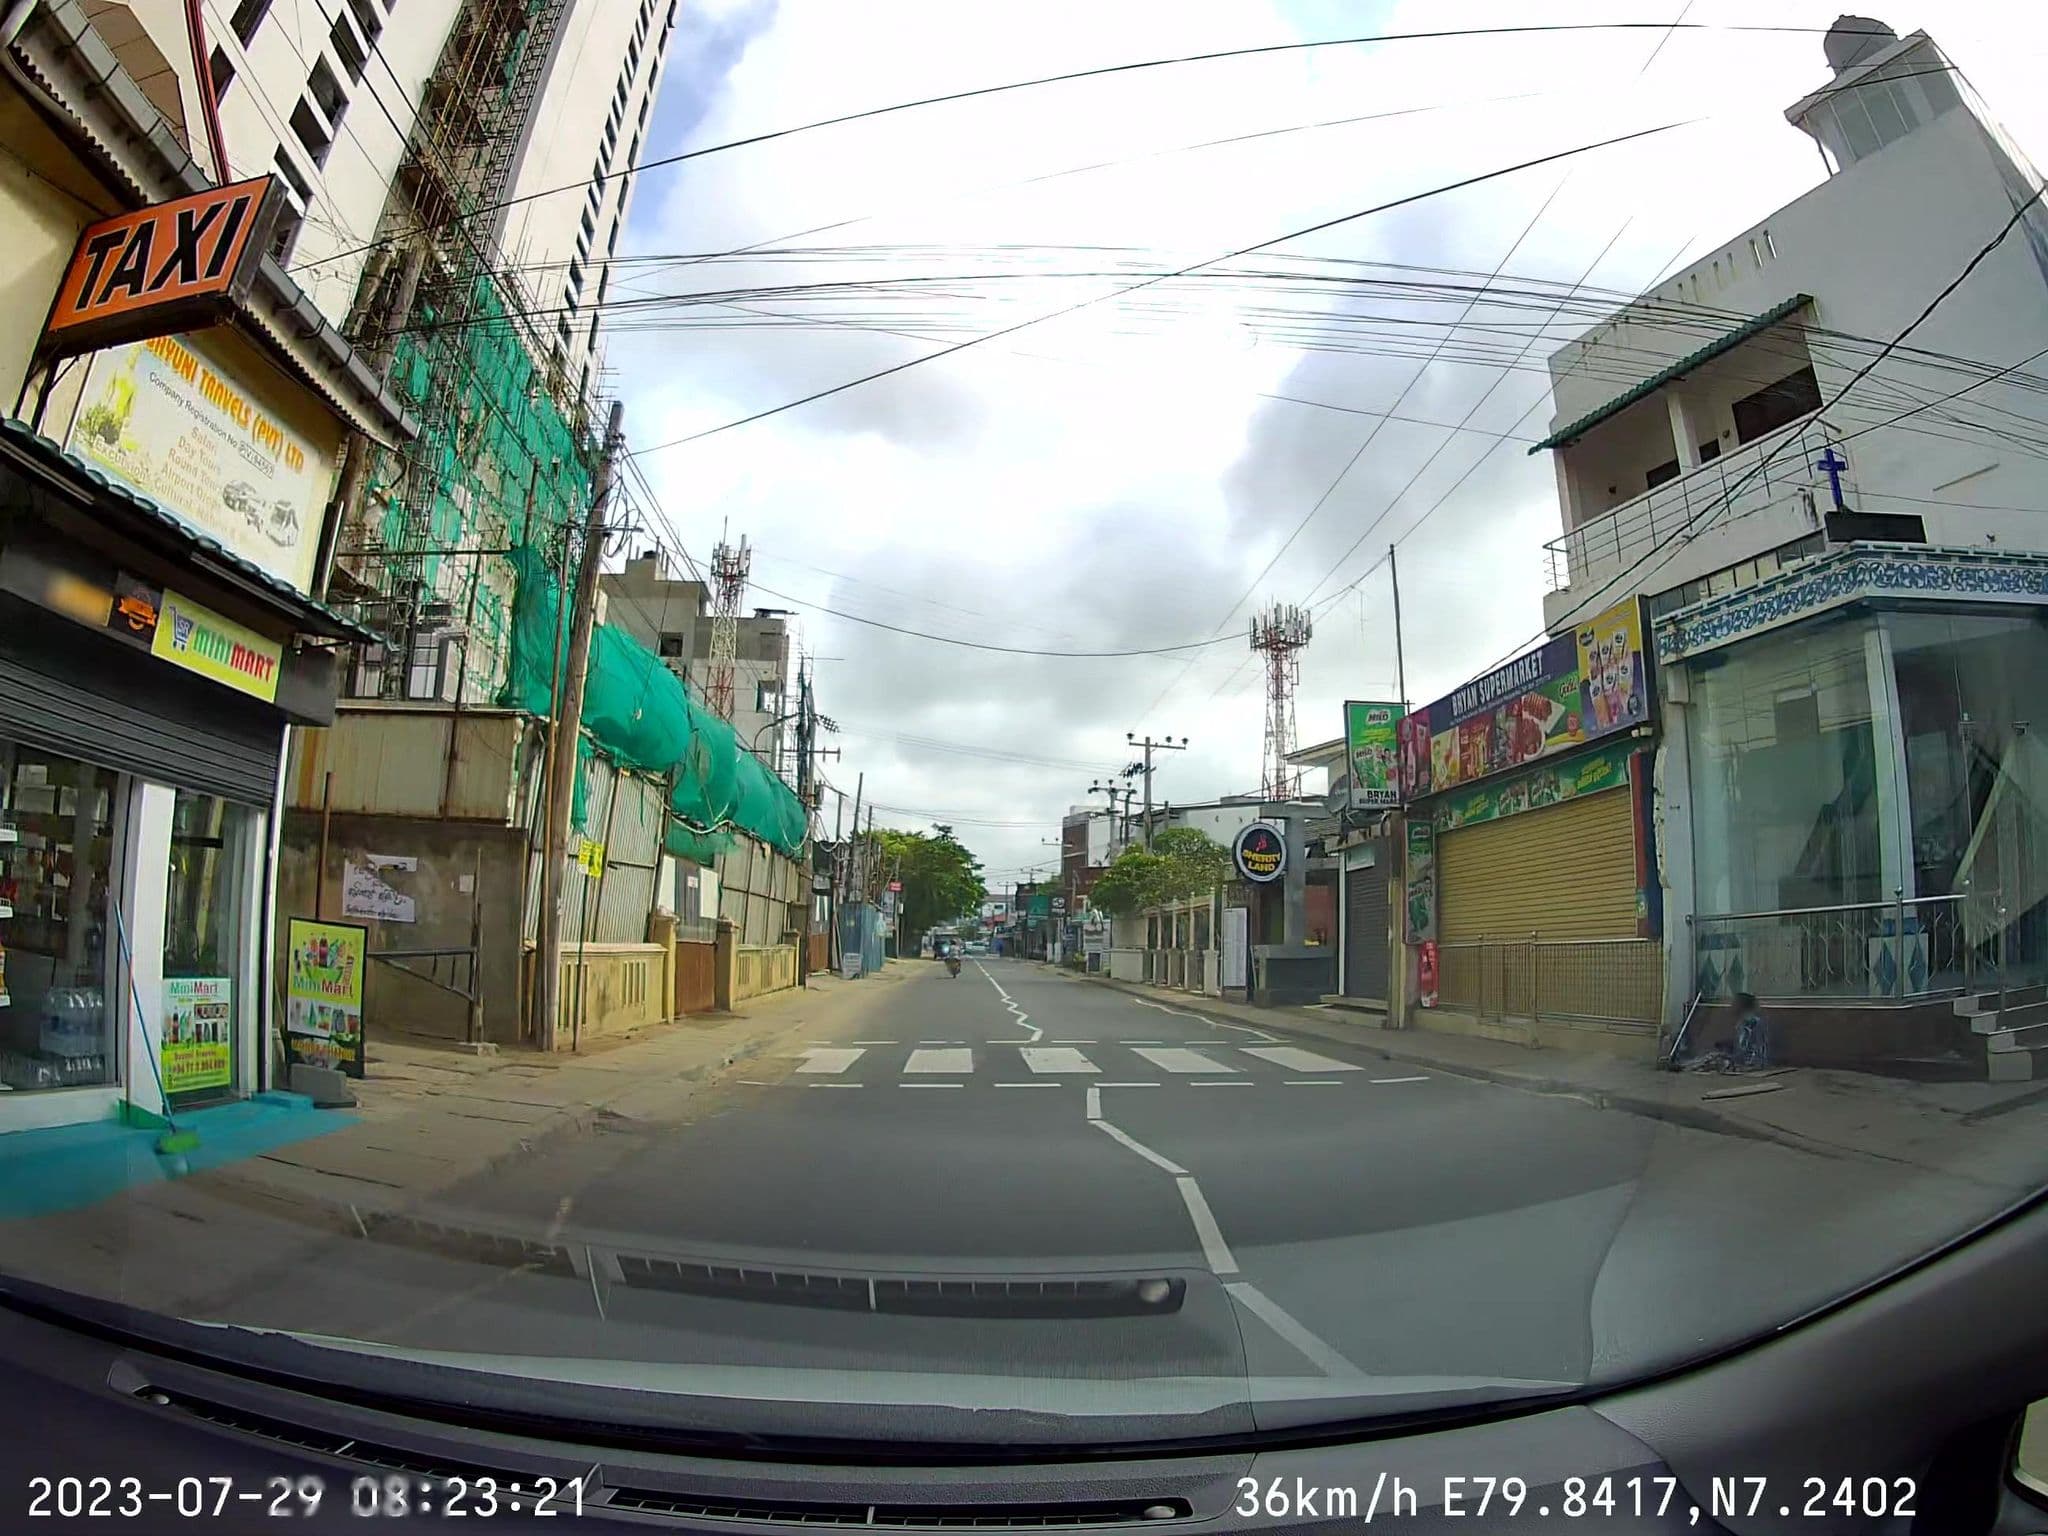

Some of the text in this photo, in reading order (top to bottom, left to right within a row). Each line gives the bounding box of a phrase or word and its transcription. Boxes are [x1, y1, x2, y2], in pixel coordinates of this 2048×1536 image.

[75, 195, 254, 313] TAXI
[149, 371, 185, 408] Company
[184, 400, 228, 441] Registration
[199, 366, 253, 431] TRAVELS
[253, 412, 284, 463] (PVT)
[285, 441, 305, 476] LTD
[1451, 683, 1479, 717] BRYAN
[1479, 649, 1543, 704] SUPERMARKET
[1366, 790, 1397, 799] BRYAN
[1247, 860, 1275, 872] LAND
